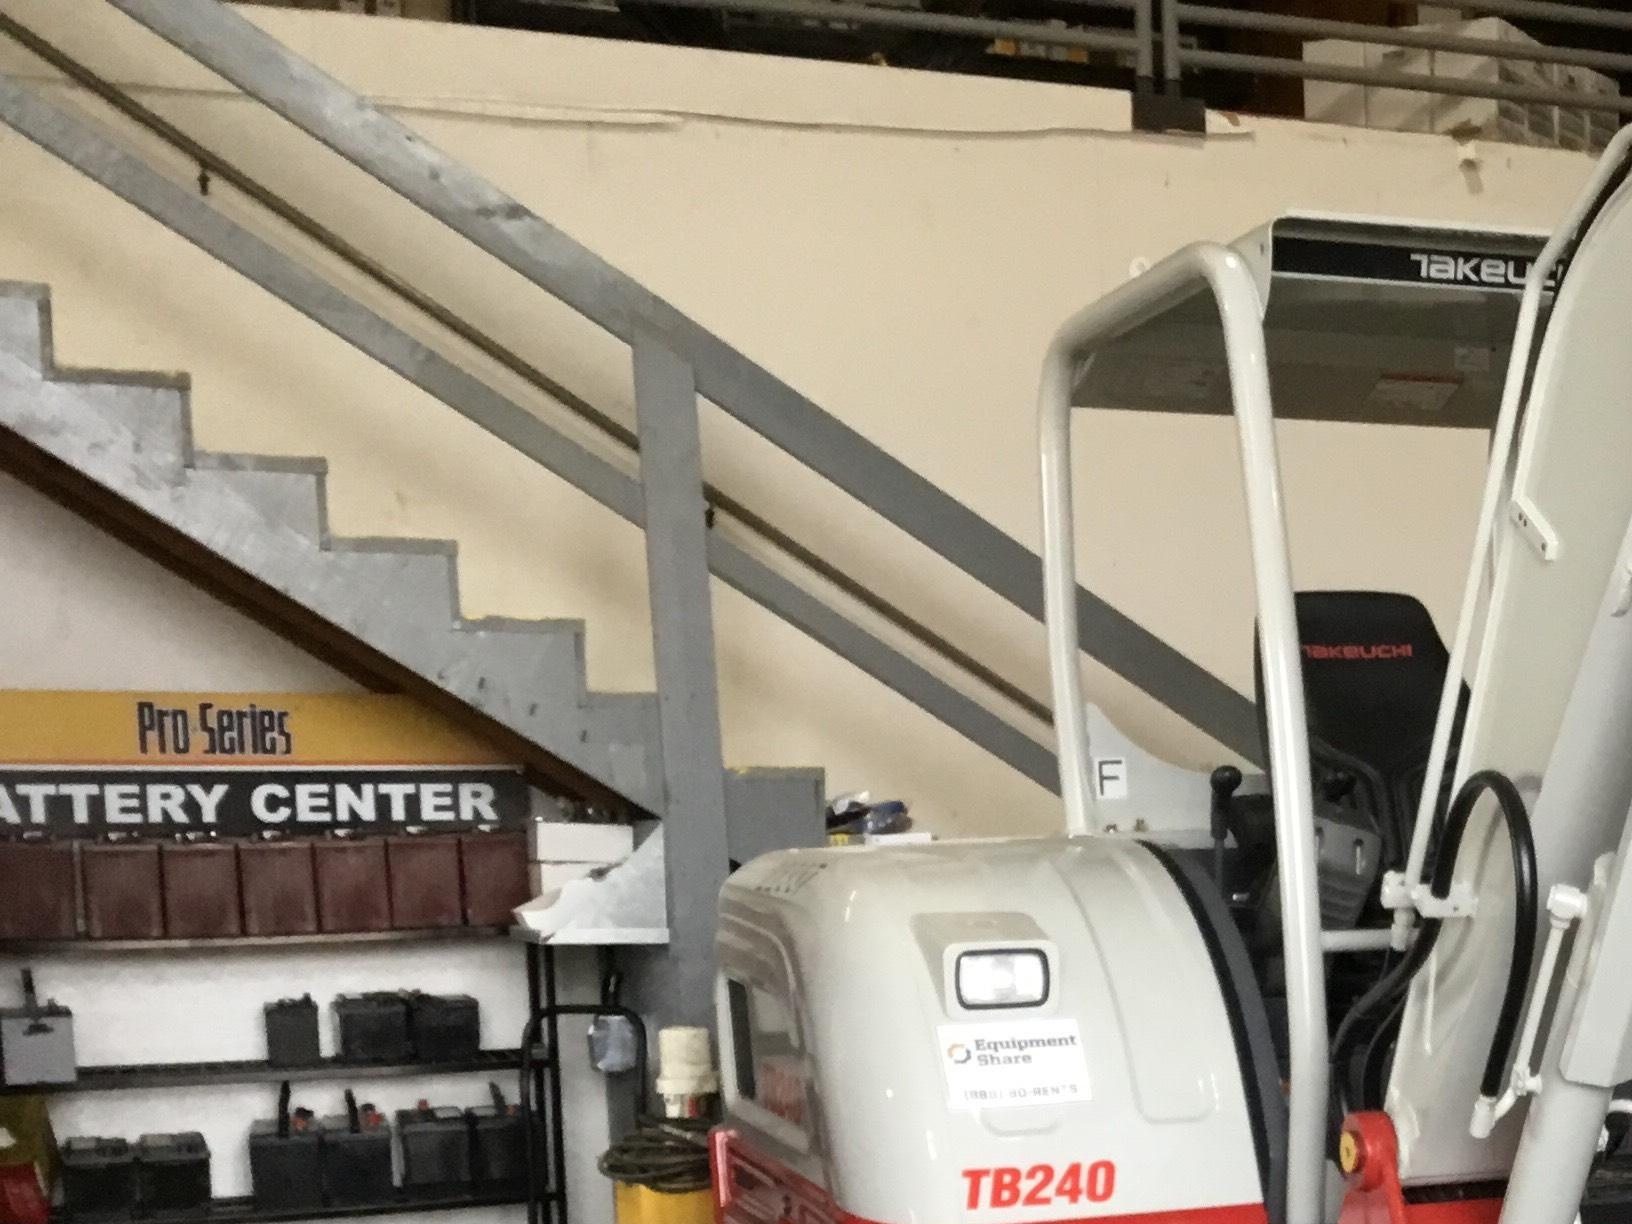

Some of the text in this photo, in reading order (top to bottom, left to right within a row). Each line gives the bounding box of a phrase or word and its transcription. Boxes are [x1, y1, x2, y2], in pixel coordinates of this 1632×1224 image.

[1410, 252, 1564, 287] TAKEU
[136, 701, 292, 755] Pro Series
[1098, 759, 1123, 796] F
[250, 782, 499, 824] CENTER
[974, 1034, 1077, 1052] Equipment
[976, 1053, 1033, 1067] Share
[962, 1159, 1117, 1211] TB240
